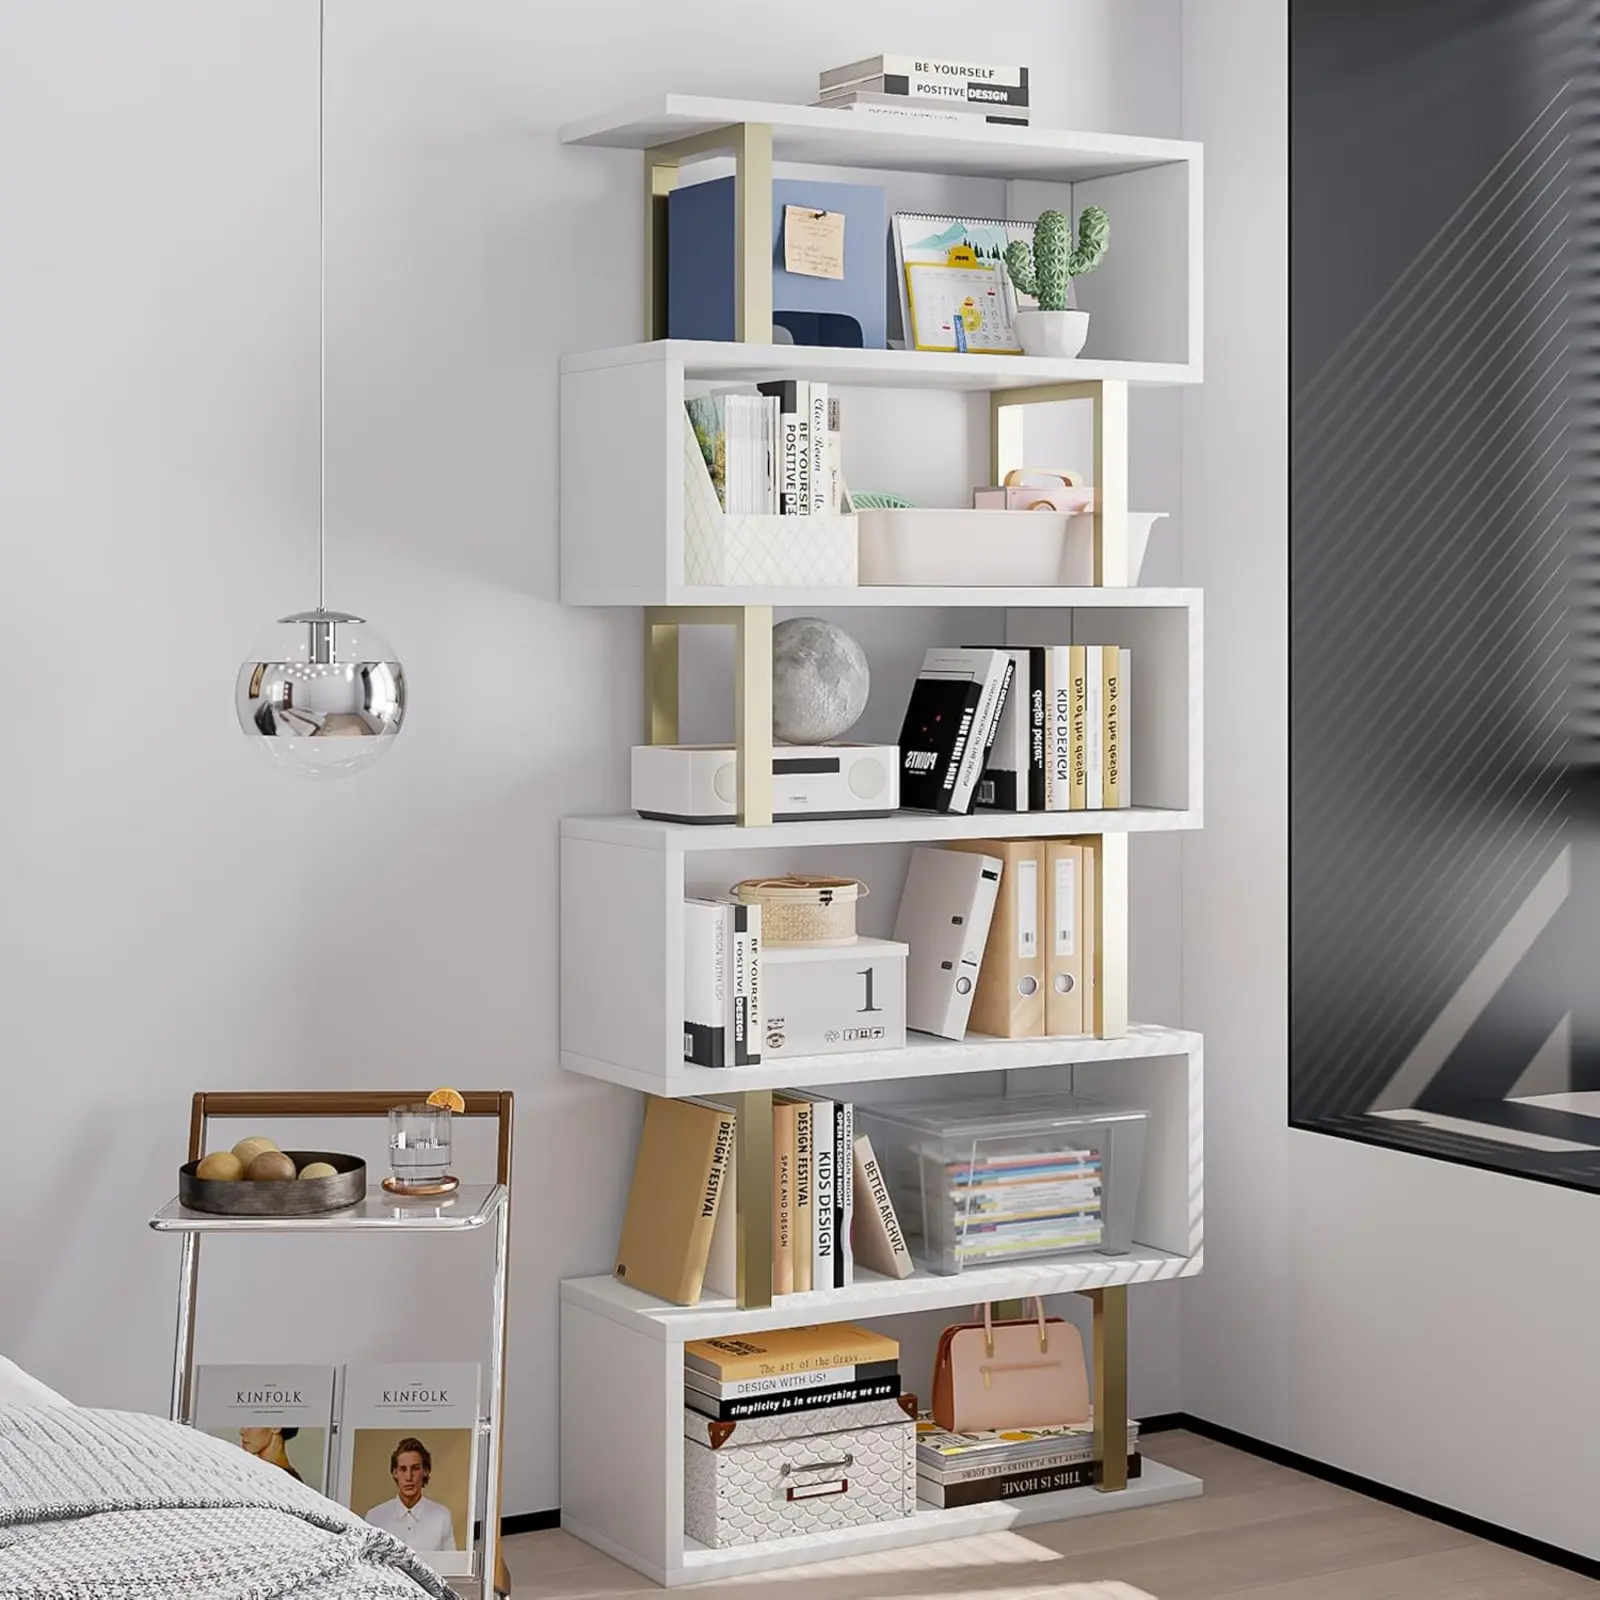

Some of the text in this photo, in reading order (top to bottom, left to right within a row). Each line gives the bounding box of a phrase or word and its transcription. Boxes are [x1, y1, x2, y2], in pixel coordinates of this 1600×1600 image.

[914, 62, 996, 79] BE YOURSELF
[916, 84, 1008, 102] POSITIVE DESIGN
[799, 422, 808, 441] BE
[814, 398, 825, 432] Class
[786, 424, 797, 490] POSITIVE
[814, 435, 825, 472] Room
[715, 920, 724, 955] DESIGN
[751, 938, 758, 954] BE
[736, 940, 744, 1042] POSITIVE DESIGN
[856, 967, 882, 1013] 1
[701, 1122, 731, 1218] DESIGN FESTIVAL
[798, 1112, 808, 1208] DESIGN FESTIVAL
[780, 1155, 788, 1248] SPACE AND DESIGN
[818, 1152, 831, 1258] KIDS DESIGN
[864, 1160, 906, 1256] BETTER ARCHVIZ
[760, 1363, 776, 1374] The
[780, 1361, 794, 1372] art
[799, 1360, 810, 1370] of
[815, 1357, 830, 1367] the
[237, 1391, 303, 1403] KINFOLK
[383, 1390, 449, 1403] KINFOLK
[730, 1384, 892, 1416] simplicity is in everything we see
[737, 1373, 827, 1394] DESIGN WITH US!
[1002, 1470, 1081, 1496] THIS IS HOME
